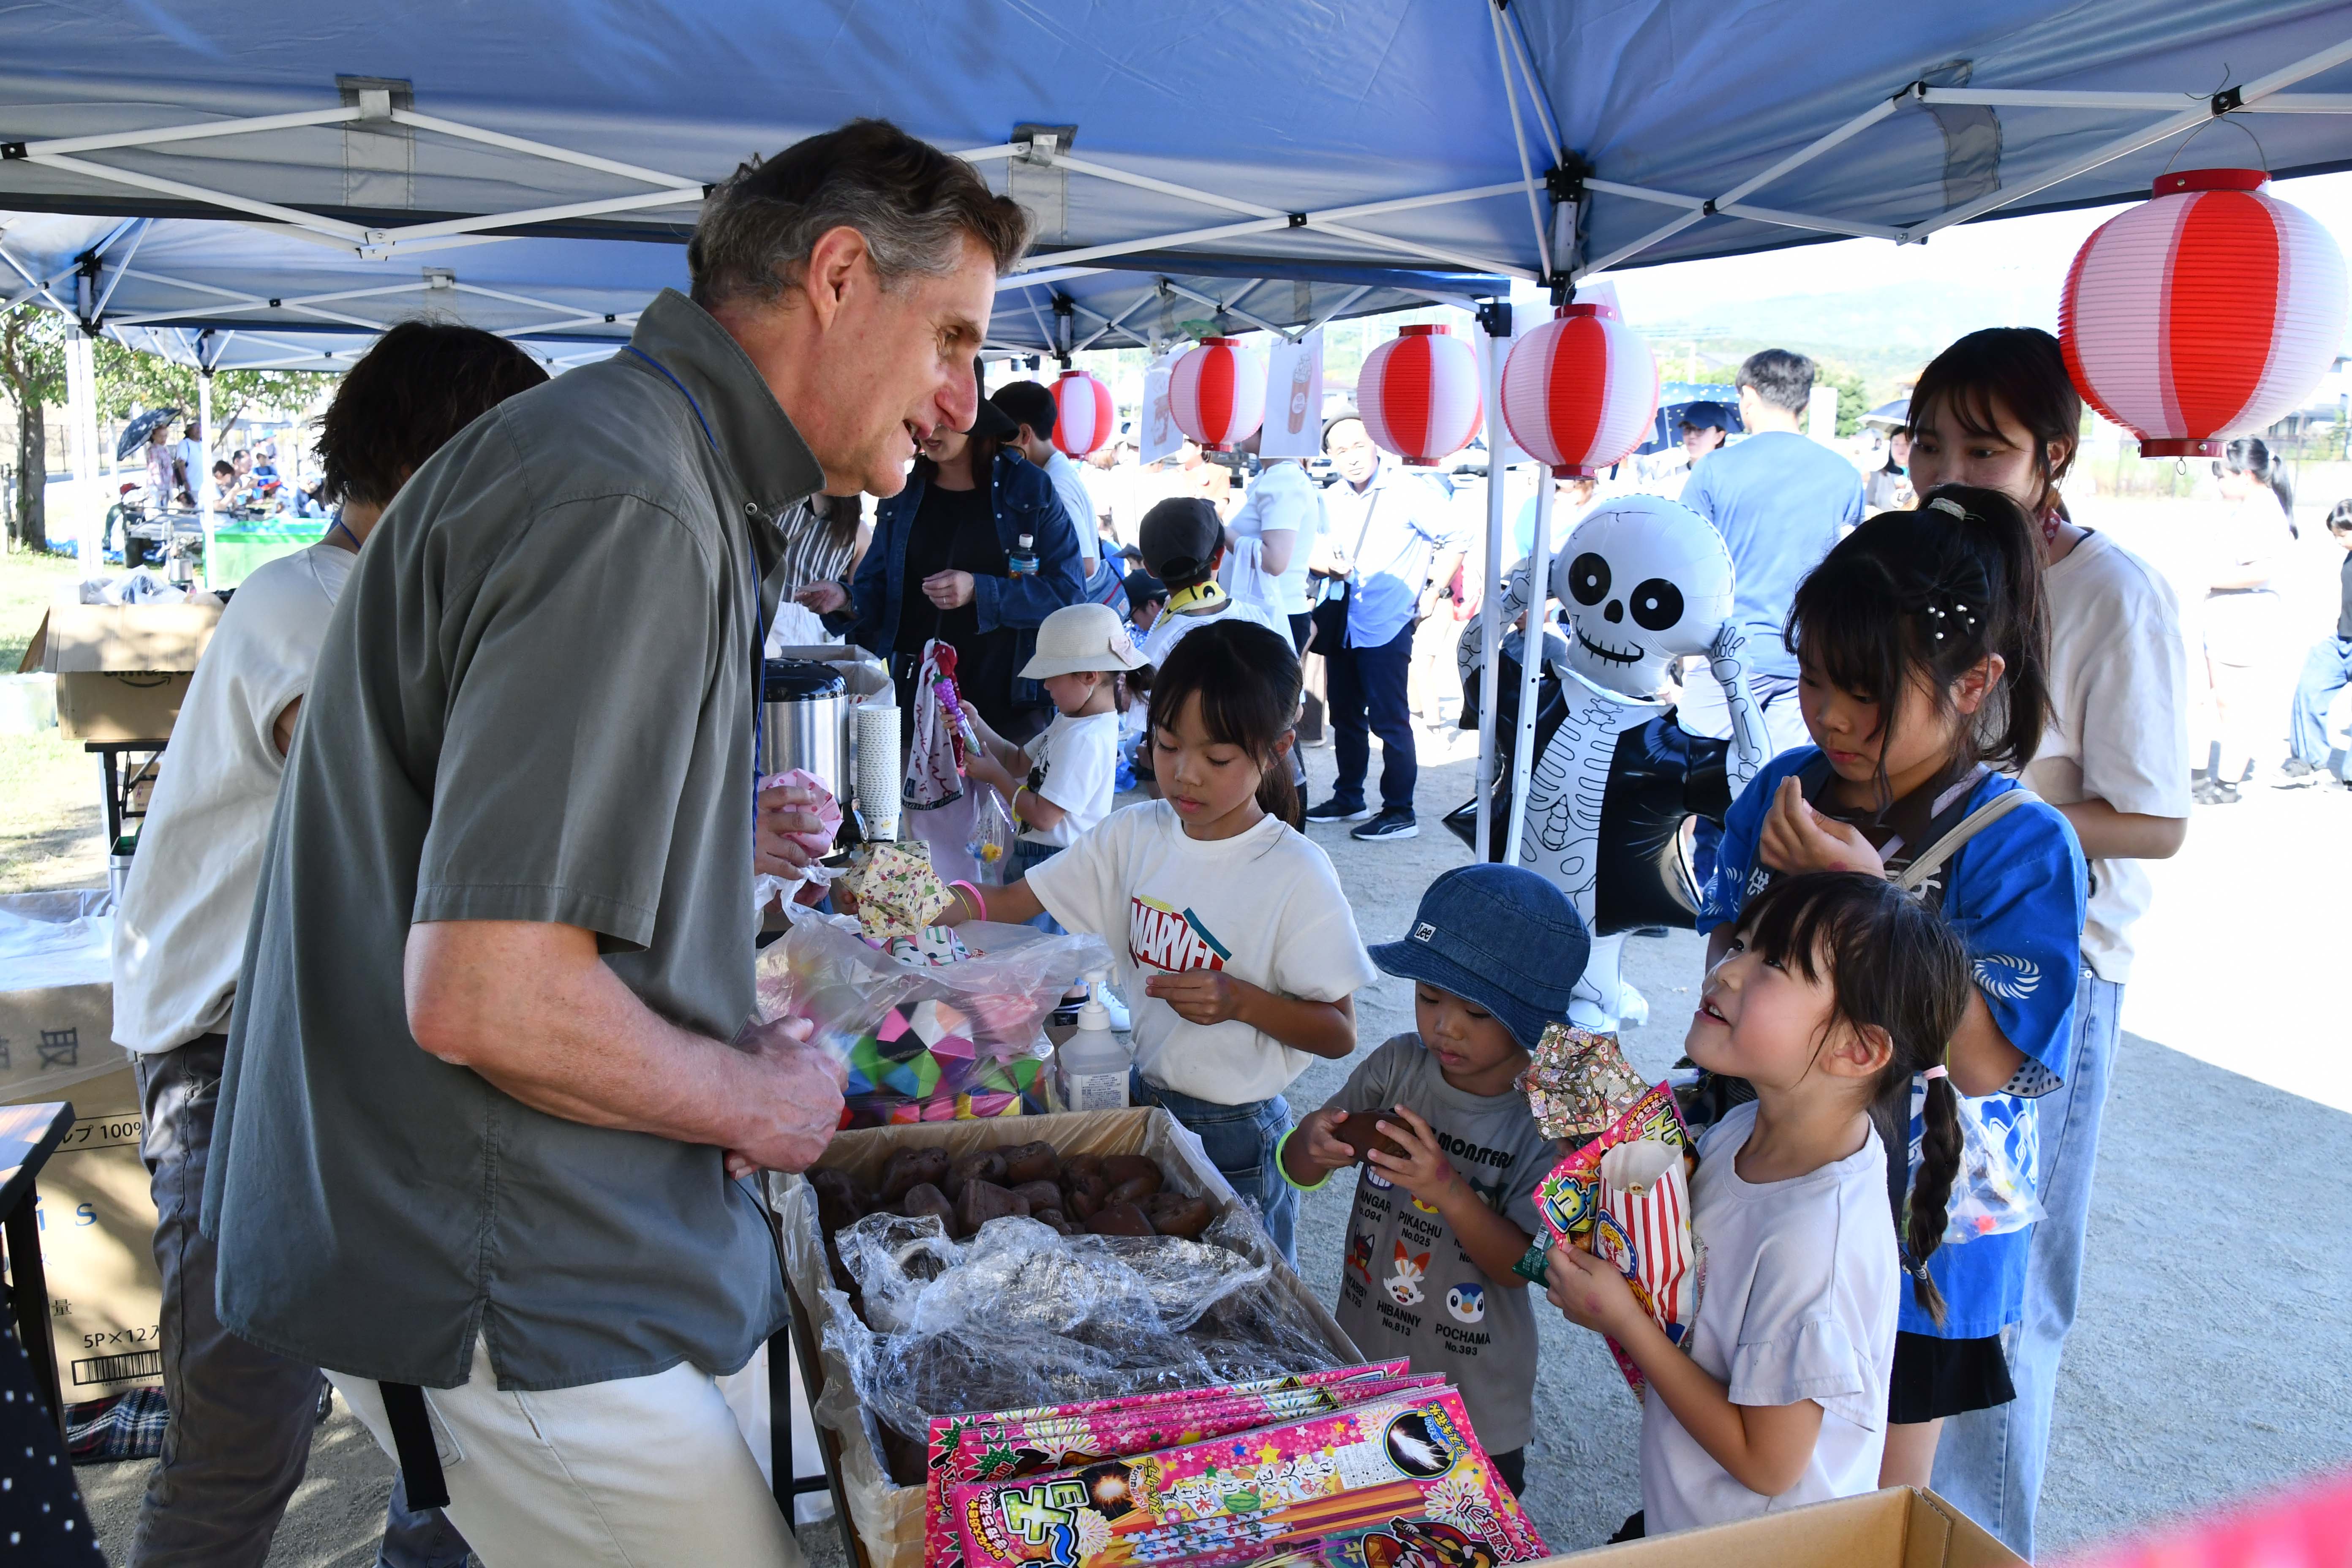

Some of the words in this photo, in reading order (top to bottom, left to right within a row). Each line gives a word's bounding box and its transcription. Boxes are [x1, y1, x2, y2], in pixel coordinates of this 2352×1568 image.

[1130, 901, 1214, 971] MARVEL
[1417, 924, 1431, 939] Lee
[1438, 1132, 1516, 1169] MONSTERS
[1358, 1205, 1382, 1222] o.094
[1360, 1190, 1391, 1213] ANGAR
[1398, 1211, 1442, 1238] PIKACHU
[1401, 1228, 1431, 1247] No.025
[1377, 1300, 1421, 1328] HIBANNY
[1382, 1317, 1411, 1337] No.813
[1435, 1323, 1491, 1345] POCHAMA
[1445, 1341, 1478, 1356] No.393
[1428, 1402, 1469, 1455] ススキ花火
[1148, 1458, 1162, 1515] スパークラー
[980, 1491, 1009, 1550] 手持ち花火
